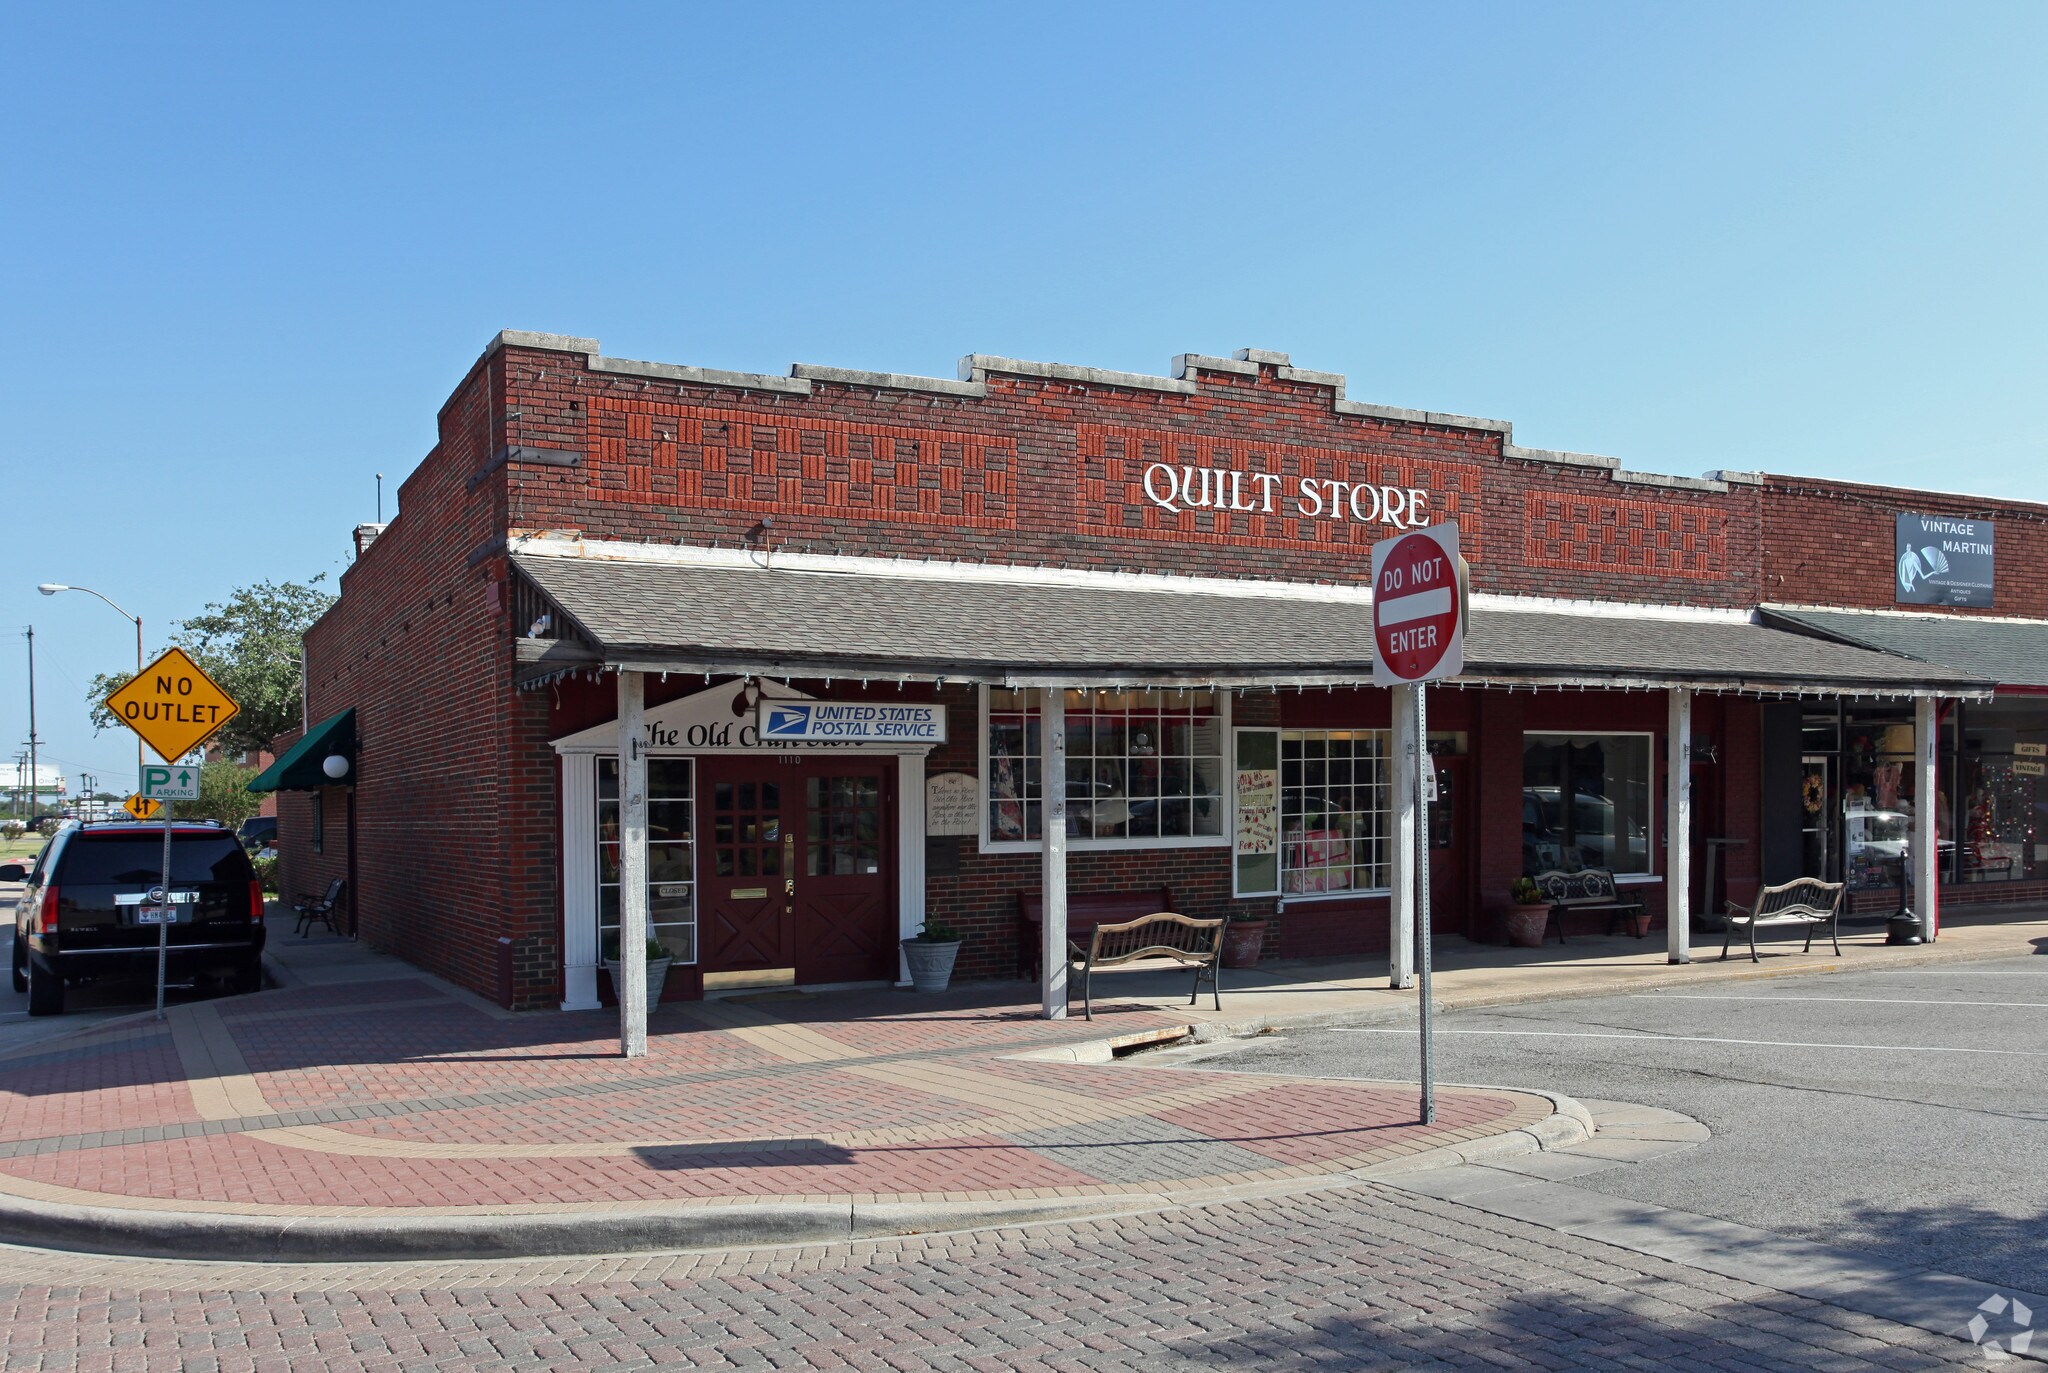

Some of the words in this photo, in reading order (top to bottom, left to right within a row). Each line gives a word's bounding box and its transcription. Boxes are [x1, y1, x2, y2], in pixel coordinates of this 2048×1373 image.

[1143, 463, 1282, 513] QUILT
[1297, 476, 1430, 530] STORE
[1921, 520, 1974, 536] VINTAGE
[1942, 540, 1993, 555] MARTINI
[1384, 567, 1403, 592] DO
[1412, 557, 1442, 585] NOT
[1390, 625, 1437, 654] ENTER
[156, 675, 193, 696] NO
[124, 701, 220, 723] OUTLET
[815, 706, 877, 721] UNITED
[878, 707, 932, 721] STATES
[687, 721, 733, 747] Old
[811, 721, 871, 736] POSTAL
[874, 723, 937, 737] SERVICE
[778, 755, 801, 764] 1110
[2015, 764, 2041, 773] VINTAGE
[145, 768, 194, 797] PARKING
[660, 887, 687, 895] CLOSED
